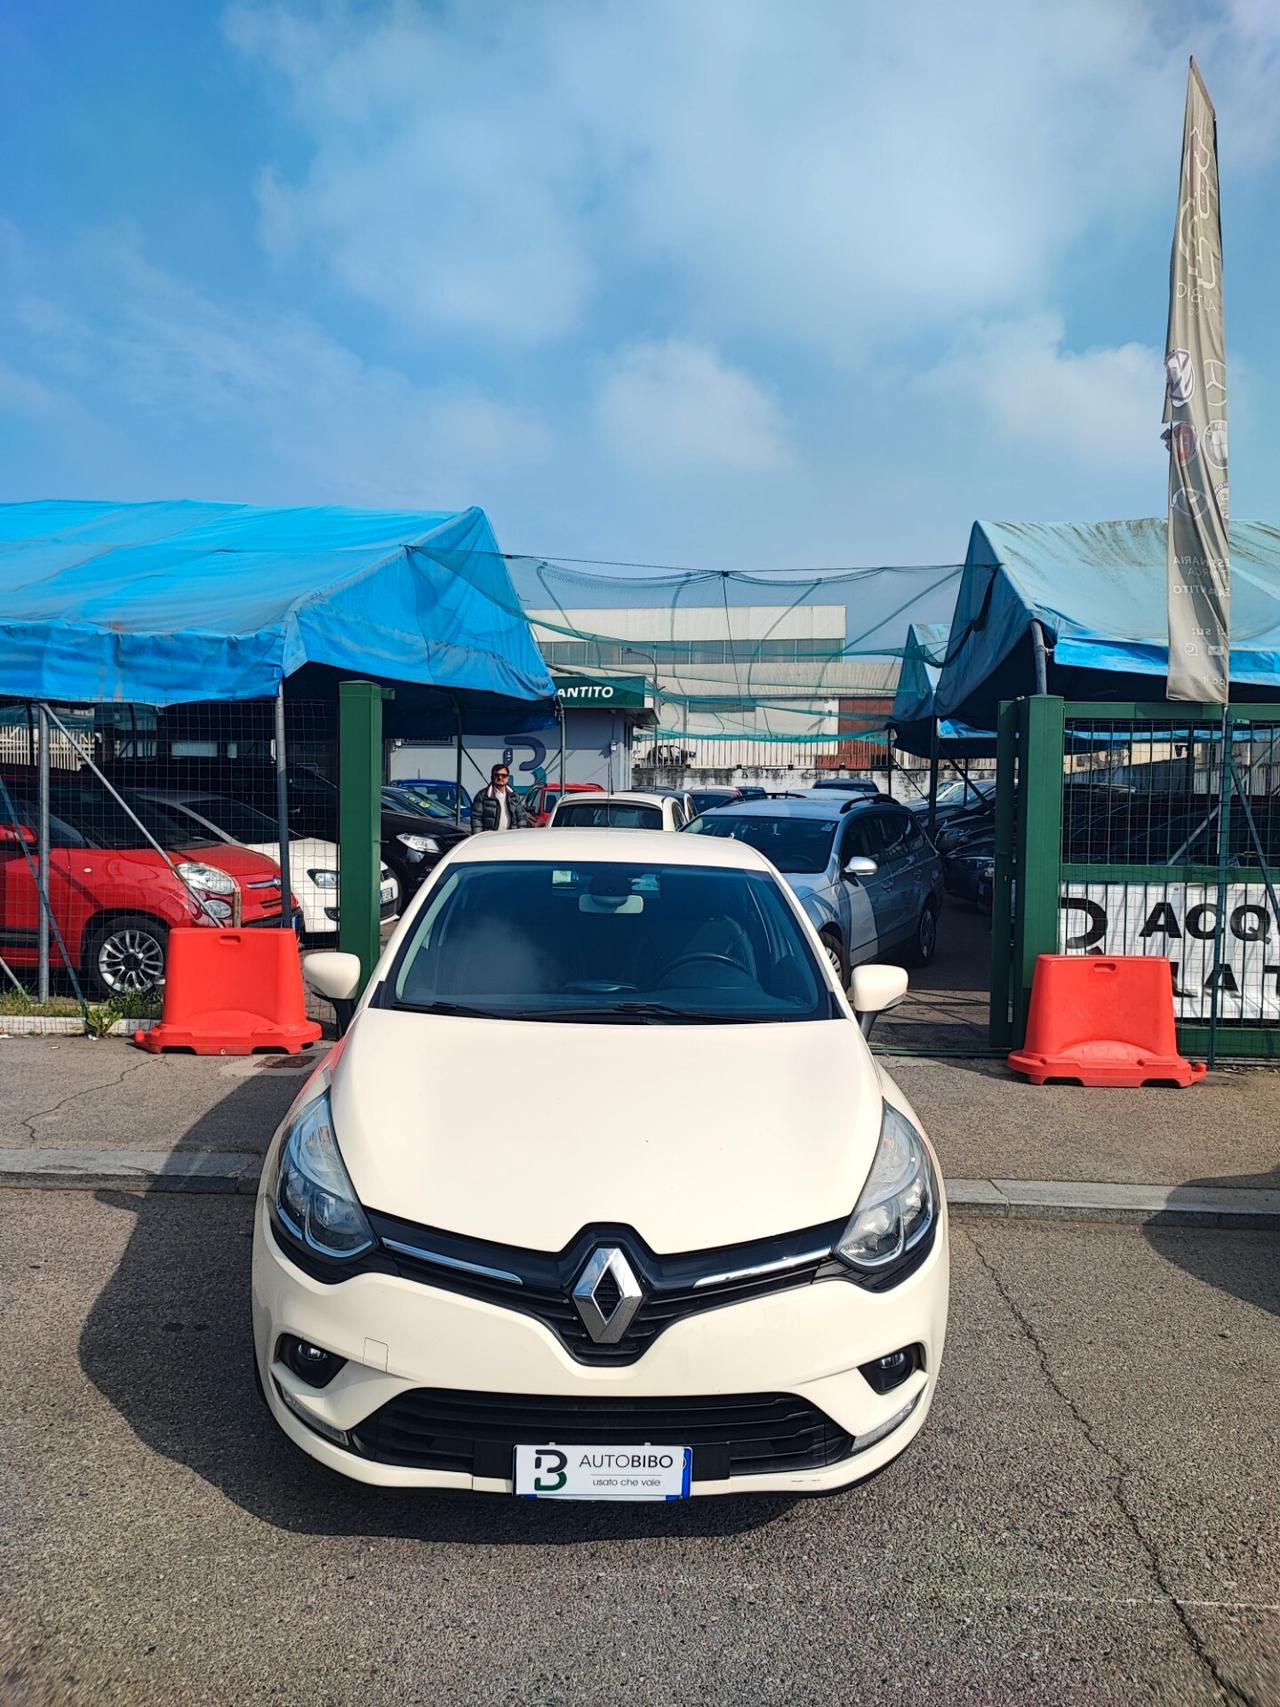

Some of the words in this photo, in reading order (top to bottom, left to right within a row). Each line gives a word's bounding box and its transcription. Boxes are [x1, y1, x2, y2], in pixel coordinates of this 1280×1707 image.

[579, 1454, 673, 1469] AUTOBIBO
[592, 1478, 618, 1487] usato
[621, 1478, 639, 1487] che
[641, 1478, 661, 1487] vale
